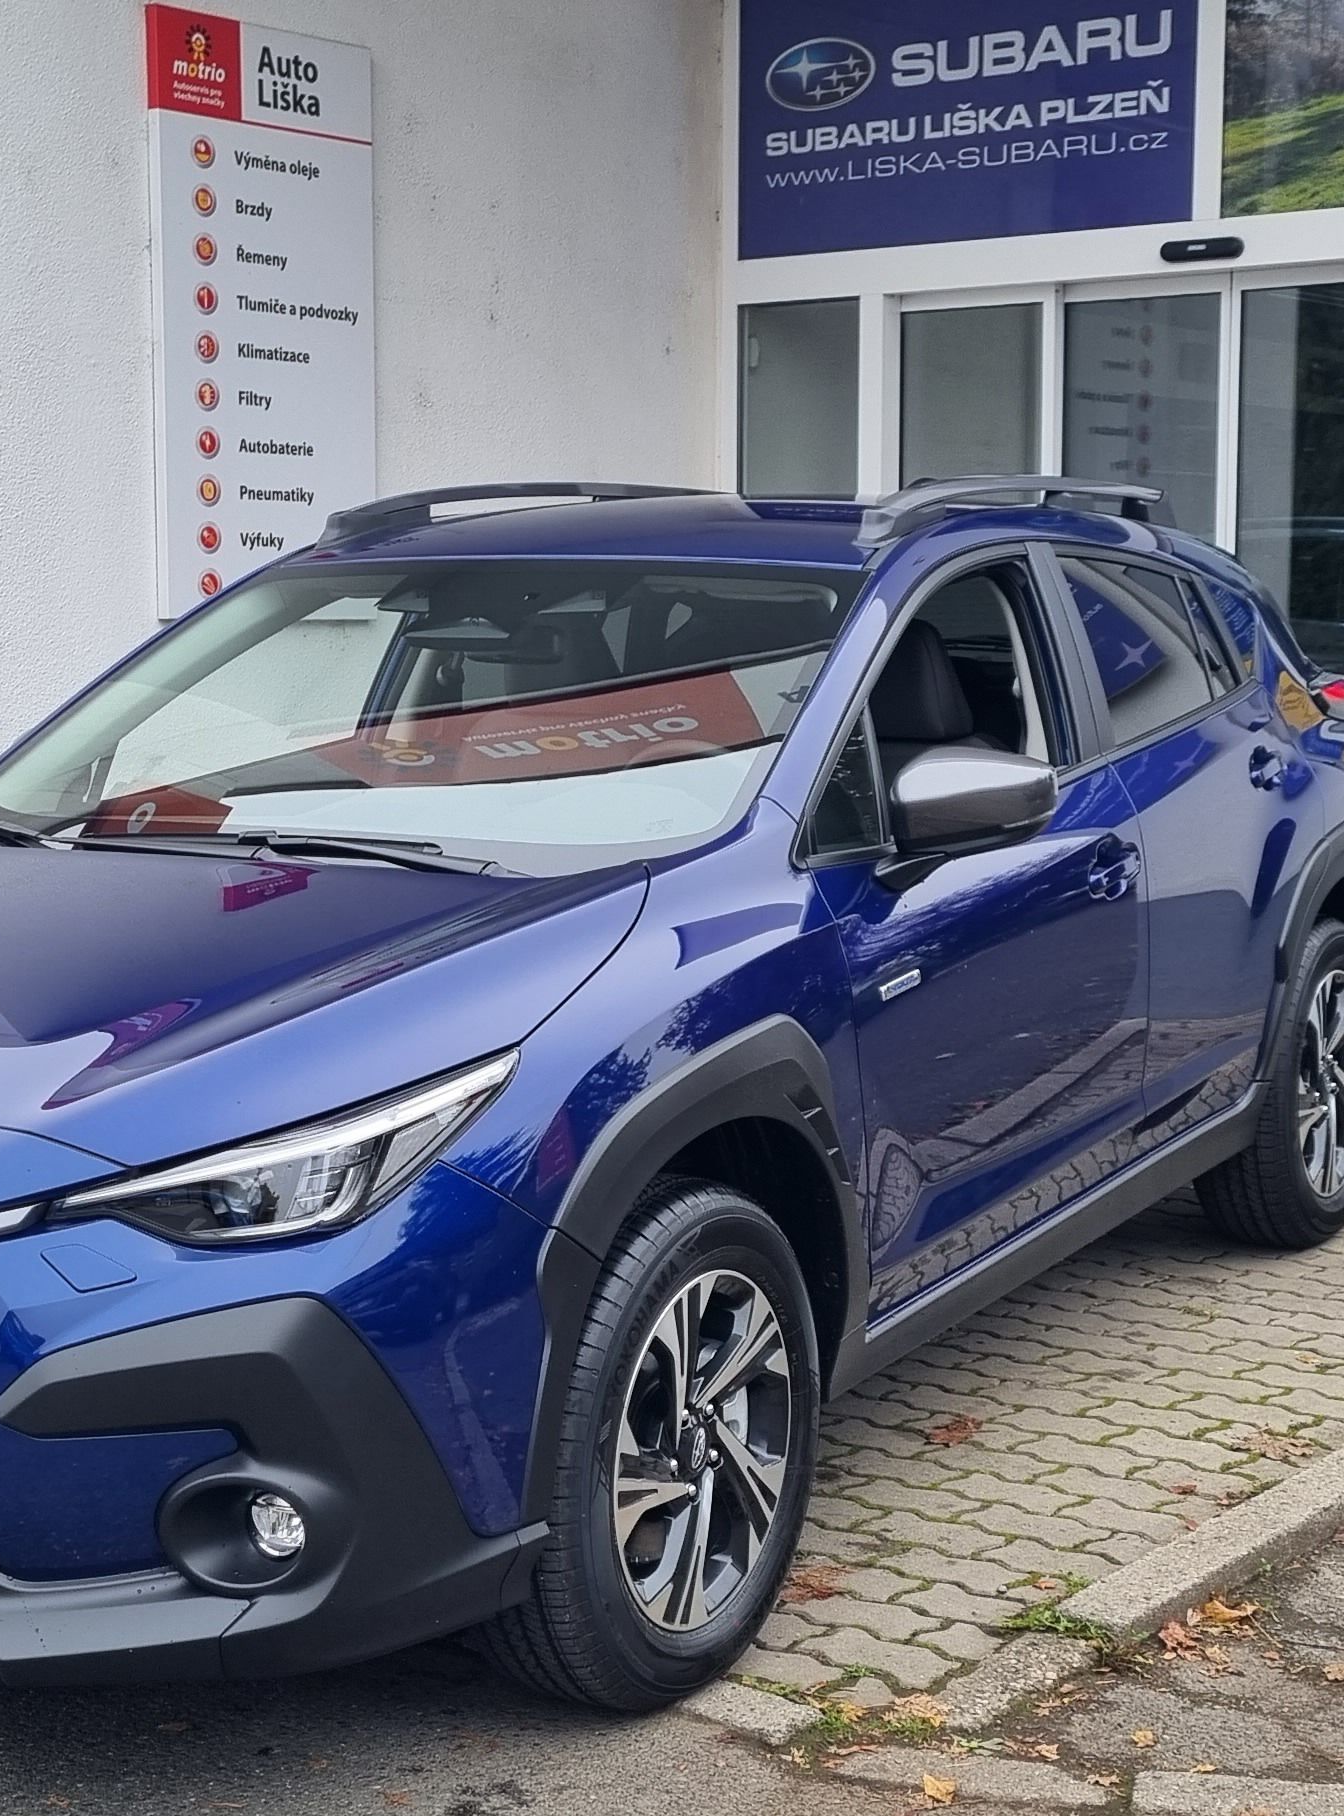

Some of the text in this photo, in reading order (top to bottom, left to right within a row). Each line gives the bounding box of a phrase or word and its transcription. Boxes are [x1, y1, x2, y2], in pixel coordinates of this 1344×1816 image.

[890, 9, 1174, 88] SUBARU
[173, 58, 226, 83] motrio
[257, 45, 318, 84] Auto
[258, 78, 320, 117] Liška
[766, 80, 1170, 157] SUBARU LIŠKA PLZEŇ
[234, 150, 320, 181] Výměna oleje
[765, 131, 1169, 188] www.LISKA-SUBARU.cz
[235, 198, 273, 222] Brzdy
[236, 244, 288, 271] Řemeny
[236, 295, 359, 326] Tlumiče a podvozky
[237, 343, 310, 364] Klimatizace
[238, 390, 272, 411] Filtry
[239, 438, 314, 457] Autobaterie
[239, 485, 314, 506] Pneumatiky
[240, 531, 284, 551] Výfuky
